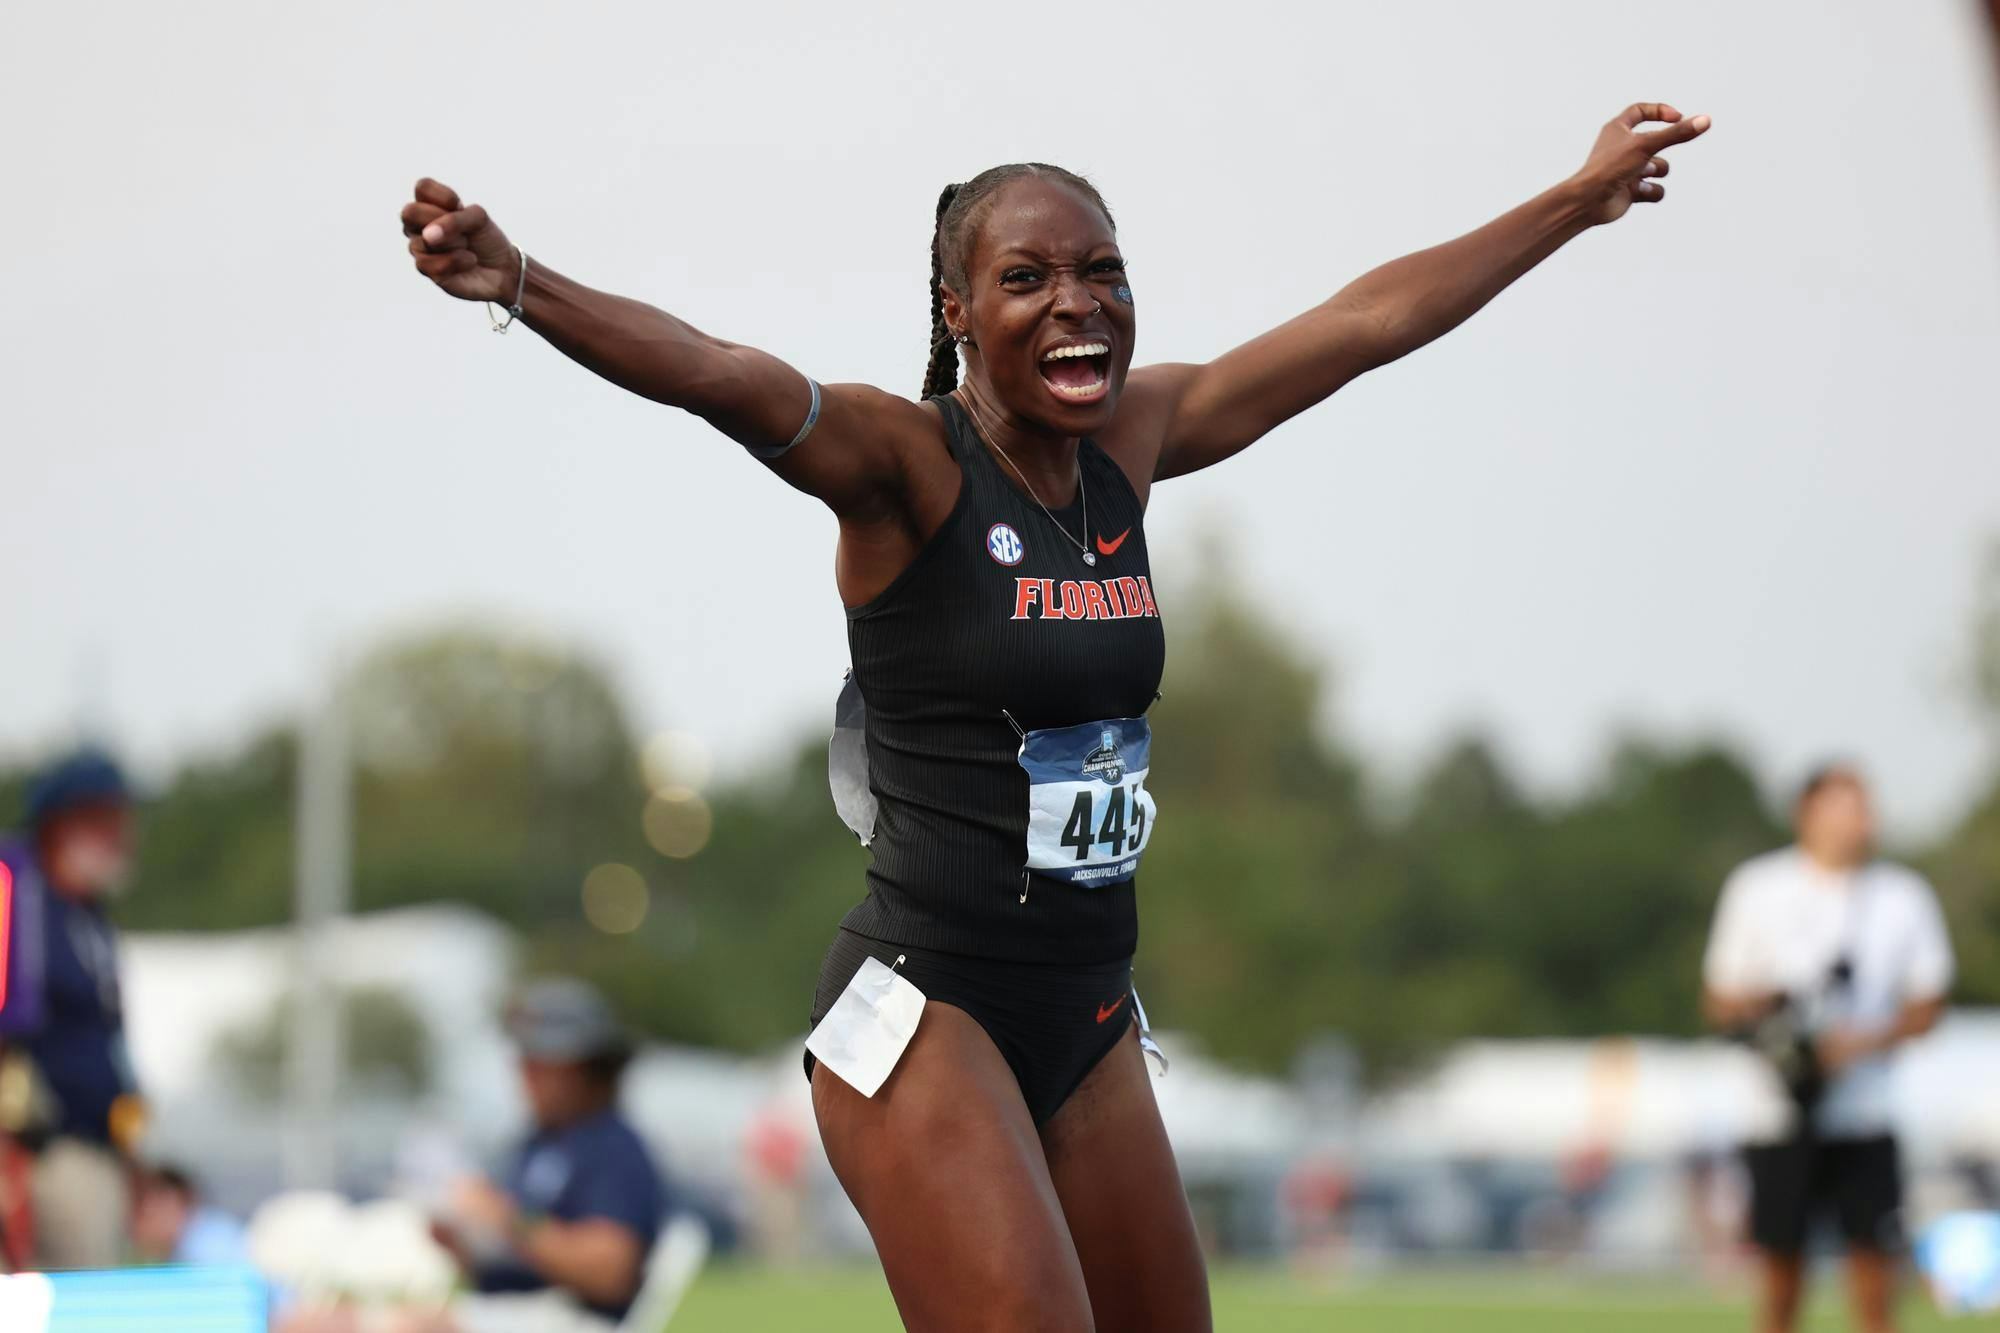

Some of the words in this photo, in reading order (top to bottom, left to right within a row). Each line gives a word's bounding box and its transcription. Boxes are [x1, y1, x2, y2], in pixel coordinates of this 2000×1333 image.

[989, 526, 1022, 562] SEC
[1010, 576, 1158, 620] FLORIDA
[1060, 783, 1146, 860] 445
